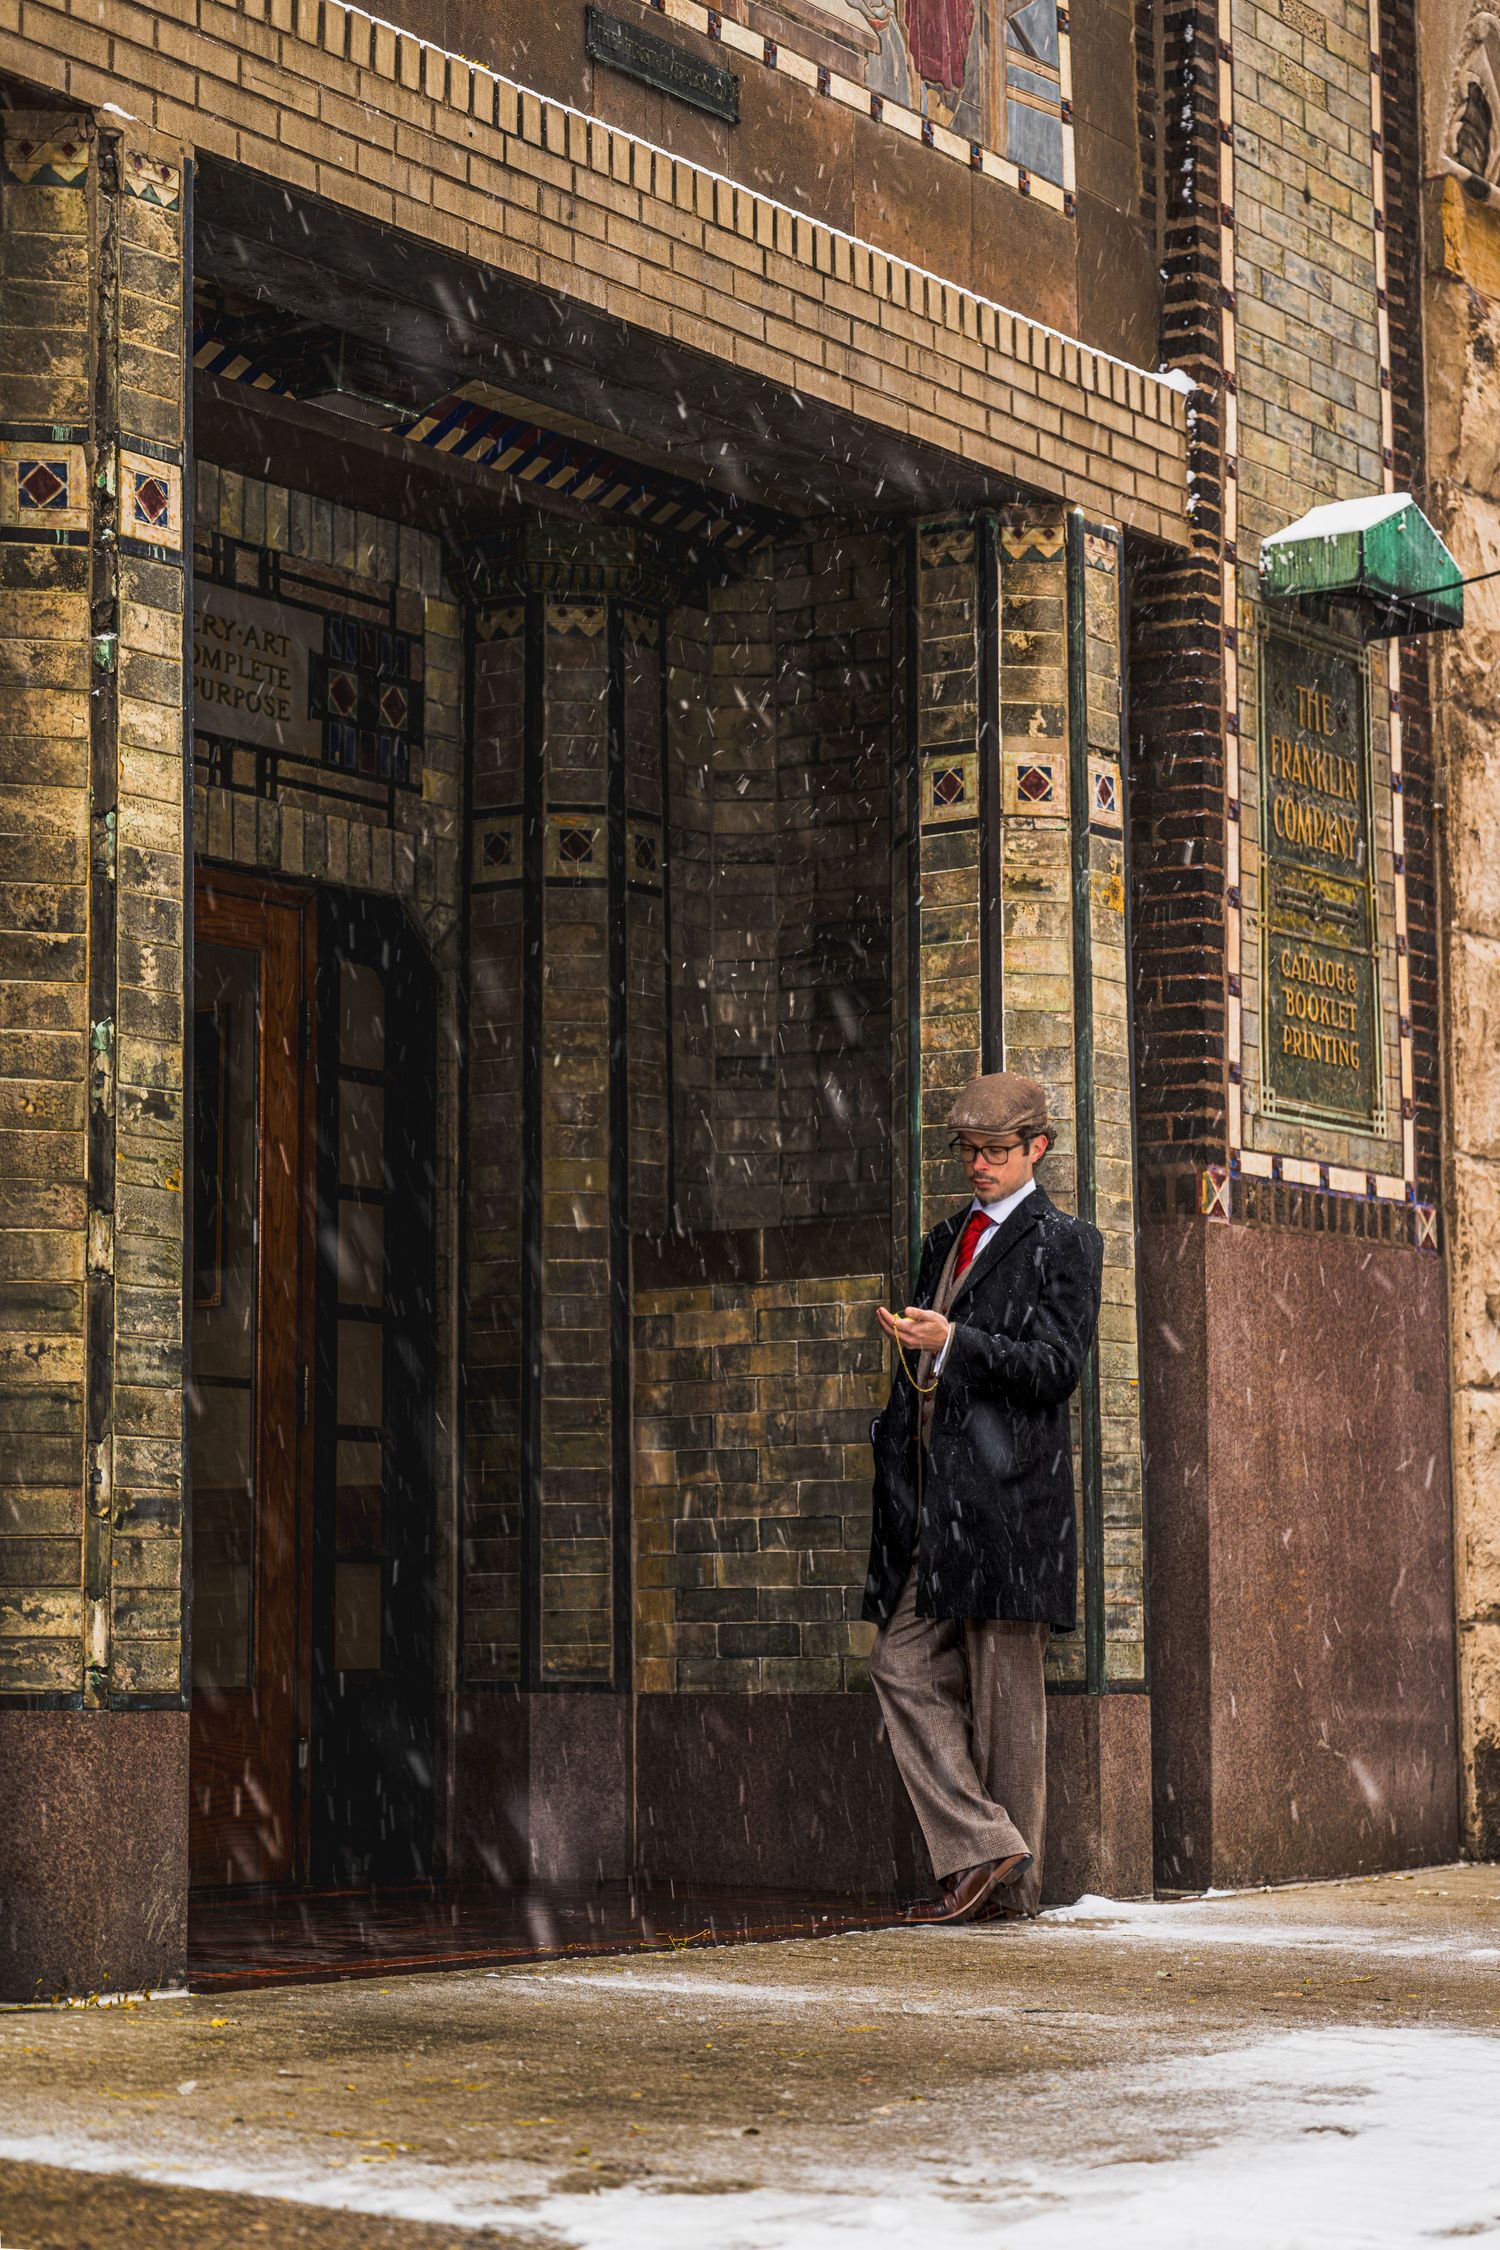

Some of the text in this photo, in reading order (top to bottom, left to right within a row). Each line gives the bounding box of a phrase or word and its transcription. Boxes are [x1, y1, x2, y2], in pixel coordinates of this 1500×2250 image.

[1296, 685, 1335, 737] THE
[1271, 734, 1359, 802] FRANKLIN
[1273, 796, 1359, 861] COMPANY
[1281, 949, 1358, 993] CATALOG &
[1281, 986, 1358, 1032] BOOKLET
[1282, 1024, 1361, 1070] PRINTING
